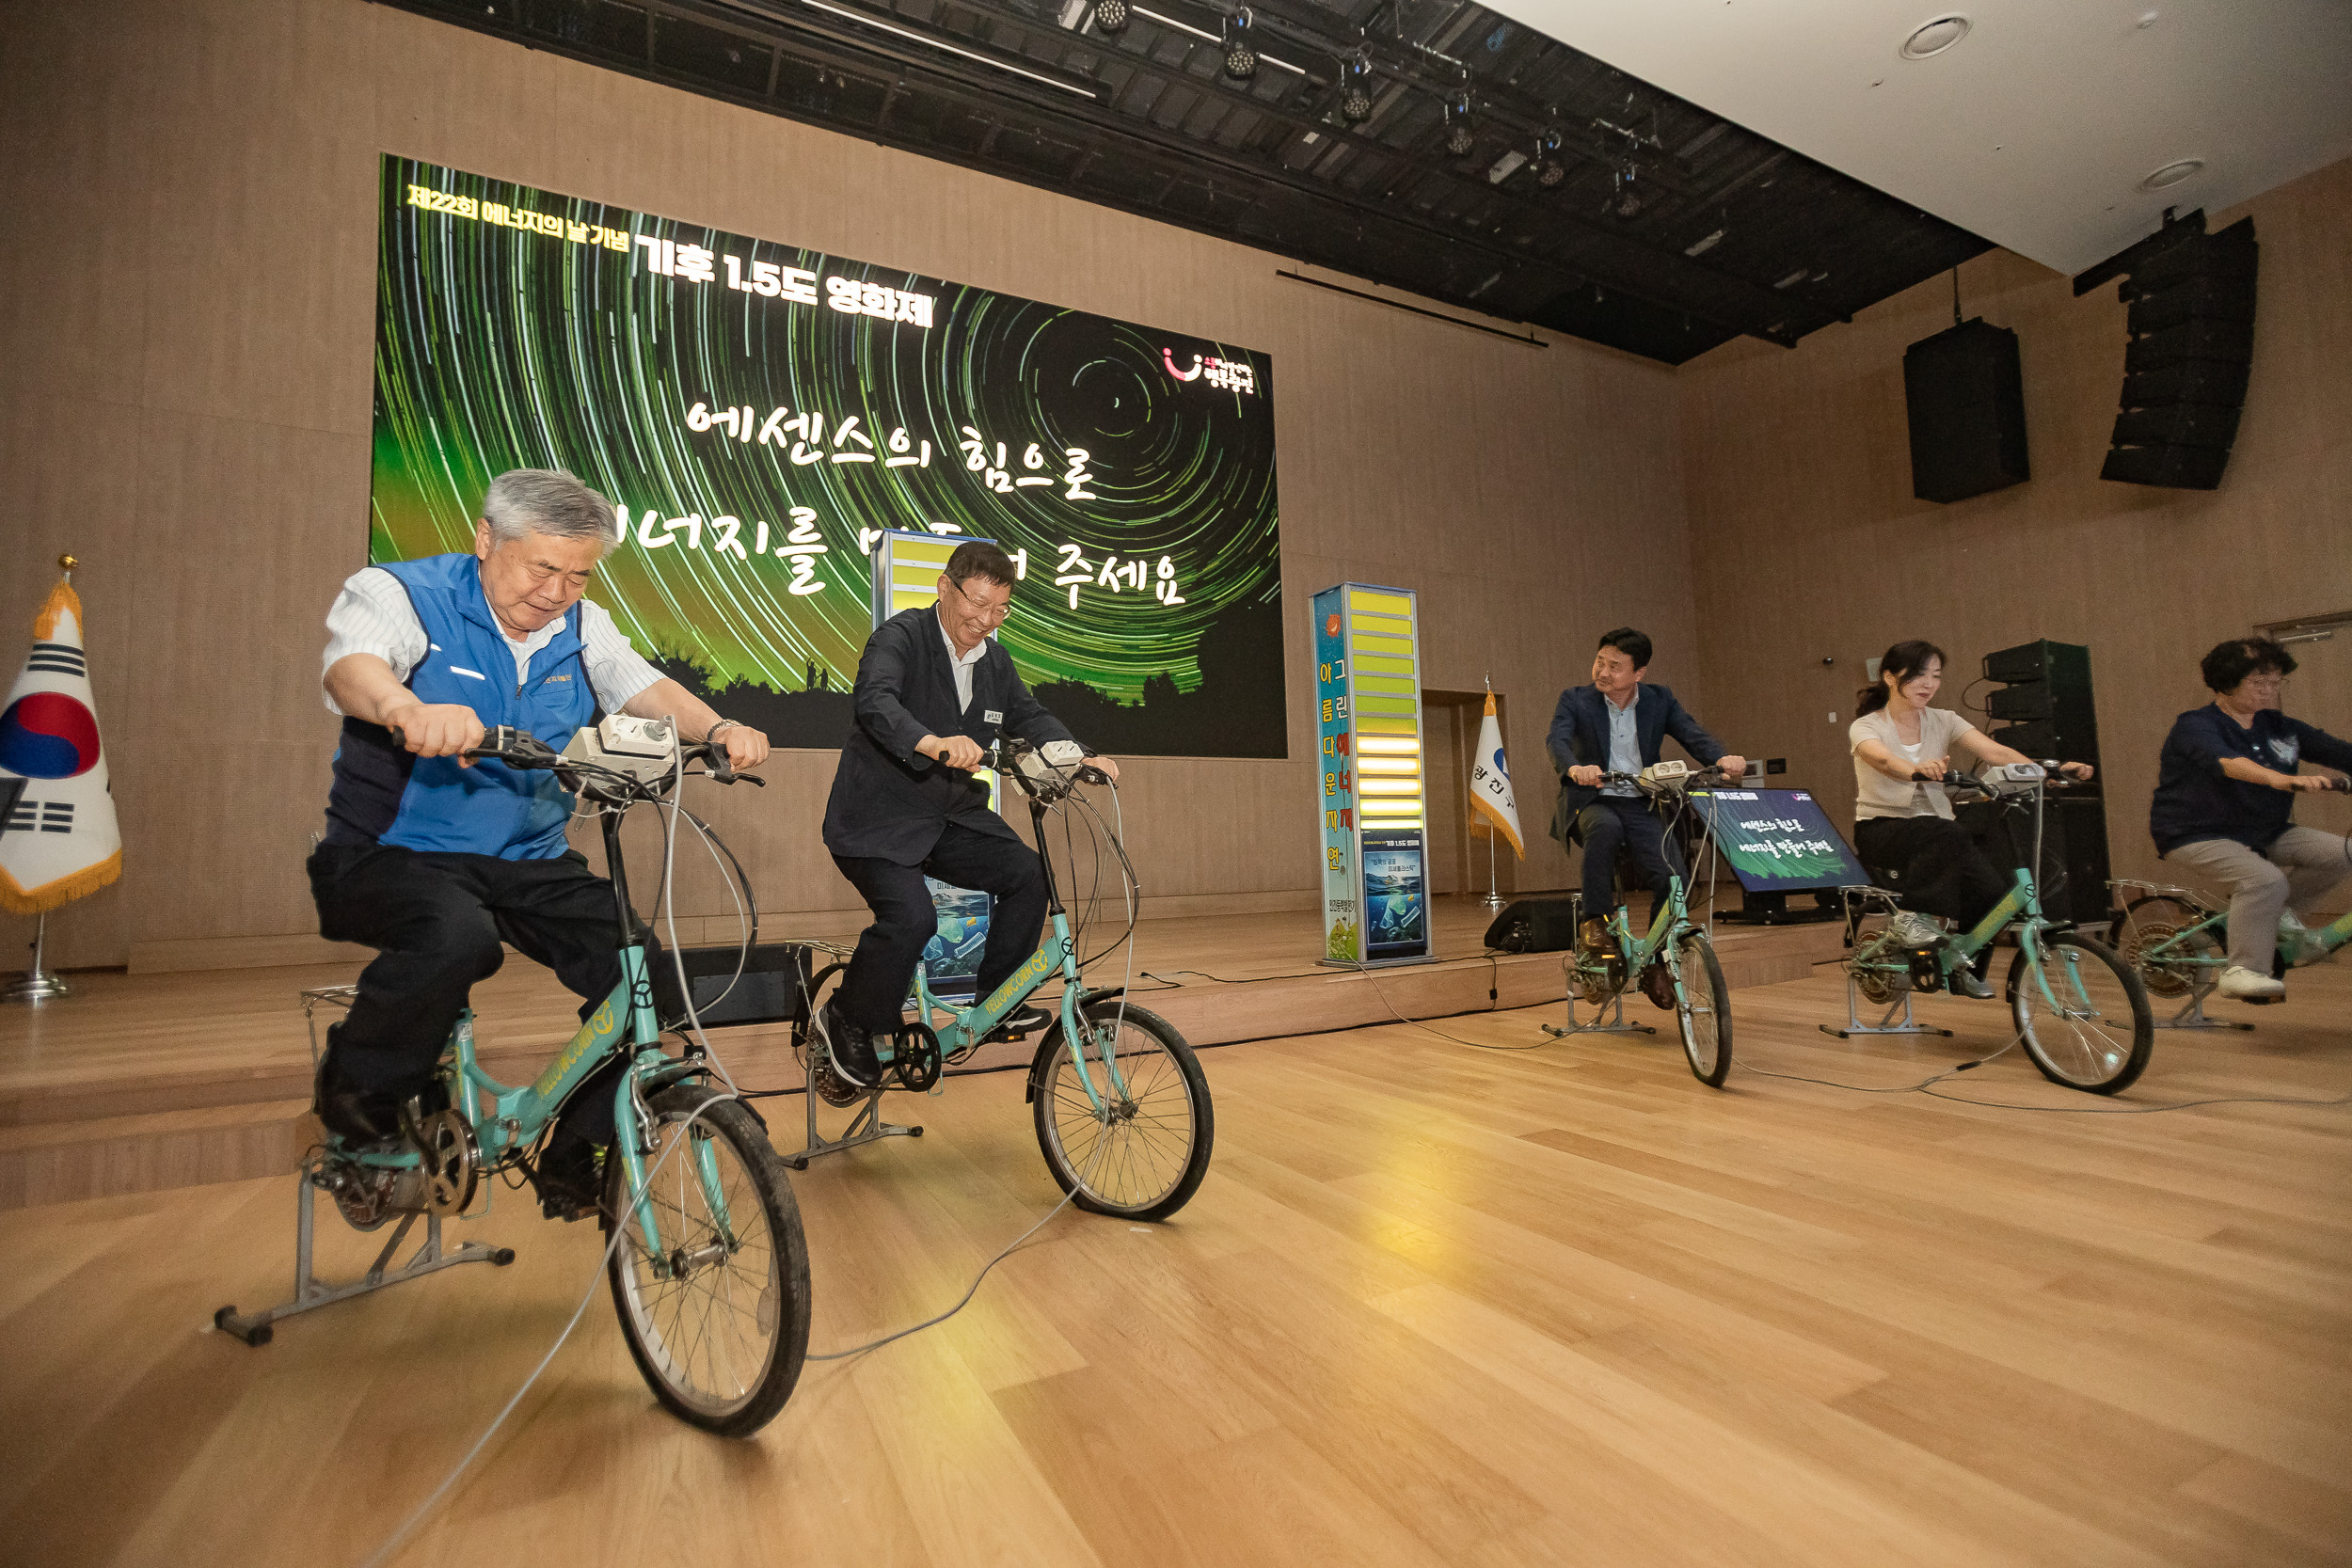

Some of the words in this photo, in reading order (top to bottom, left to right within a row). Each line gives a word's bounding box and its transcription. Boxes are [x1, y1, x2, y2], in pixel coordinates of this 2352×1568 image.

[407, 184, 478, 220] 제22회
[481, 200, 564, 238] 에너지의
[565, 219, 590, 244] 날
[590, 224, 629, 252] 기념
[634, 234, 715, 283] 기후
[723, 254, 818, 306] 1.5도
[825, 276, 933, 328] 영화제
[686, 402, 931, 467] 에센스의
[959, 425, 1097, 501] 힘으로
[1054, 543, 1187, 610] 주세요
[1474, 765, 1515, 808] 광진구
[984, 963, 1034, 1015] YELLOWCORN
